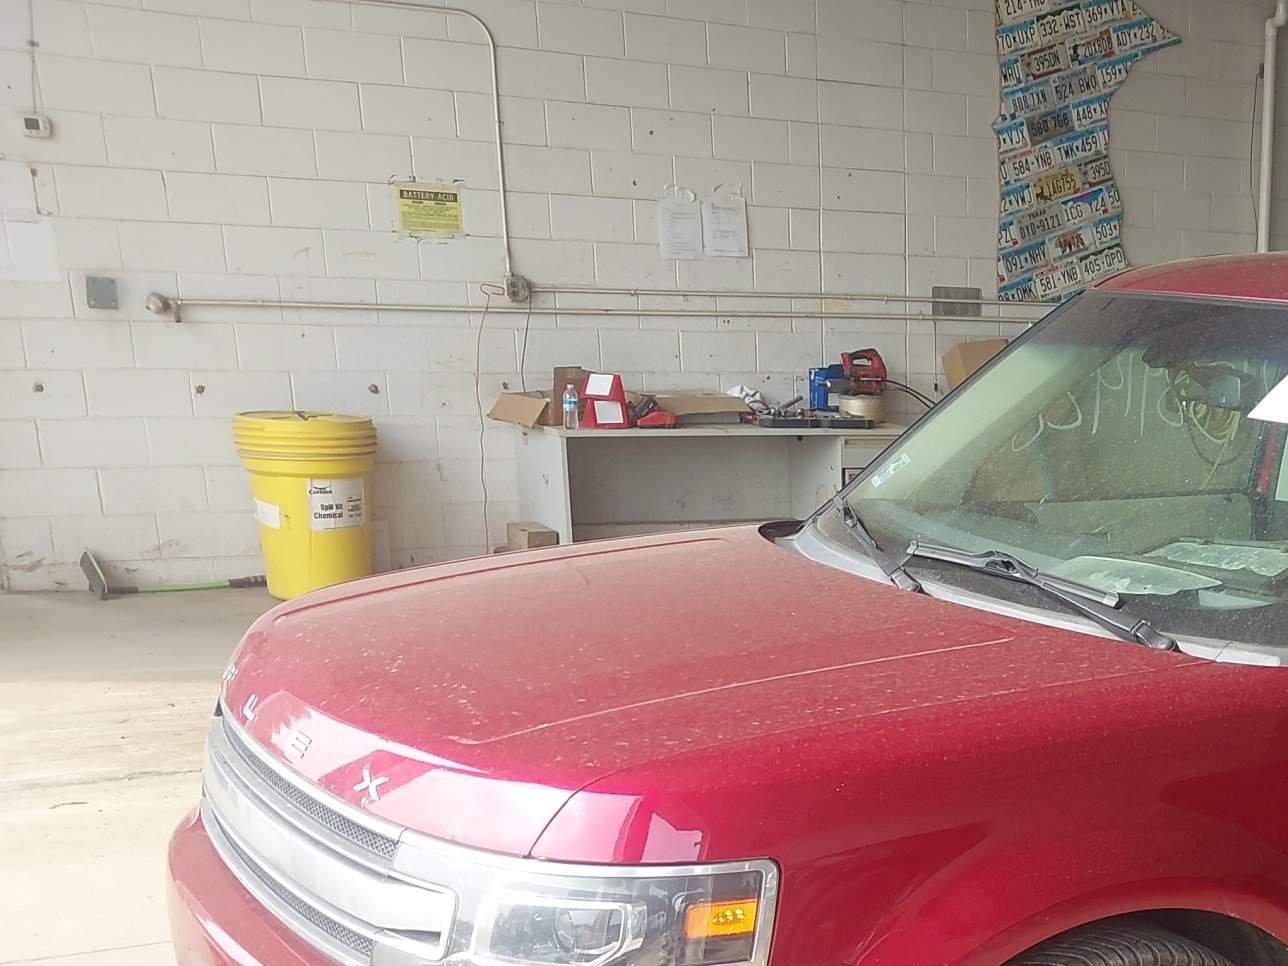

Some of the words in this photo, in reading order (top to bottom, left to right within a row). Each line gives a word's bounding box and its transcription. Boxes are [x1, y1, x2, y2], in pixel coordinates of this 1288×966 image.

[403, 191, 435, 200] BATTERY
[437, 193, 454, 201] ACID
[314, 511, 344, 519] Chemical
